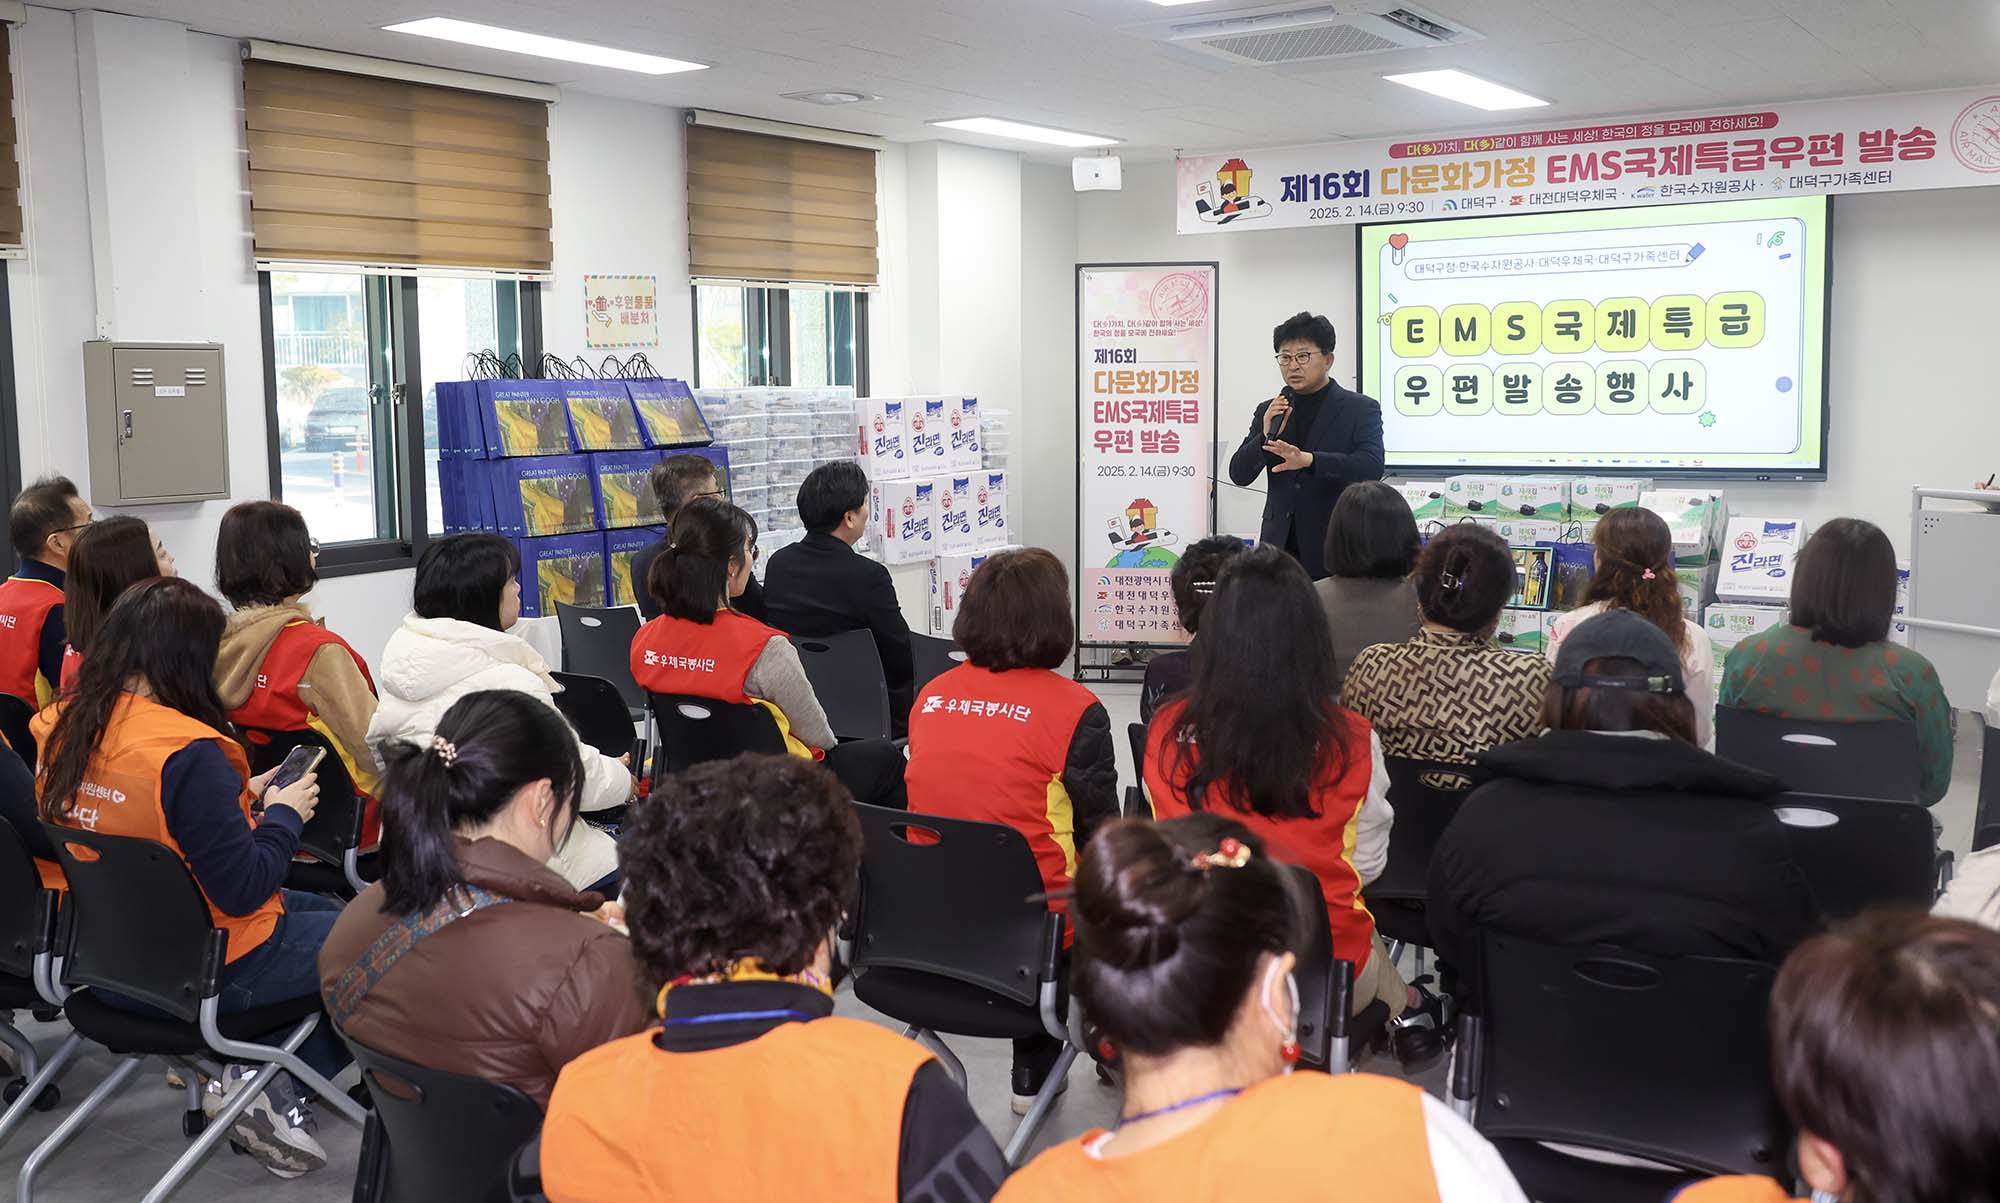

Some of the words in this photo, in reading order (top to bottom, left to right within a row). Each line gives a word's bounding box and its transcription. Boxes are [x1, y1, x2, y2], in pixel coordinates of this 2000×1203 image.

[1520, 135, 1543, 147] 함께
[1546, 133, 1569, 144] 사는
[1572, 130, 1599, 142] 세상!
[1602, 126, 1637, 140] 한국의
[1641, 125, 1664, 137] 정을
[1669, 120, 1705, 135] 모국에
[1709, 116, 1764, 132] 전하세요!
[1280, 168, 1370, 202] 제16회
[1380, 156, 1536, 195] 다문화가정
[1547, 132, 1844, 185] EMS국제특급우편
[1859, 126, 1937, 164] 발송
[1660, 179, 1756, 198] 한국수자원공사
[1789, 170, 1892, 189] 대덕구가족센터
[1461, 196, 1497, 209] 대덕구
[1529, 187, 1617, 206] 대전대덕우체국
[1309, 207, 1342, 220] 2025.
[1345, 206, 1355, 217] 2.
[1359, 202, 1395, 216] 14.(금)
[1397, 201, 1425, 213] 9:30
[615, 296, 653, 310] 후원물품
[620, 312, 649, 325] 배분처
[1094, 348, 1137, 364] 제16회
[1093, 370, 1200, 395] 다문화가정
[1093, 400, 1199, 424] EMS국제특급
[875, 434, 900, 456] 진라면
[913, 432, 940, 453] 진라면
[951, 429, 975, 449] 진라면
[1093, 429, 1134, 454] 우편
[1140, 429, 1180, 454] 발송
[1097, 466, 1127, 477] 2025.
[1128, 466, 1138, 477] 2.
[1140, 465, 1170, 478] 14.(금)
[1172, 466, 1195, 477] 9:30
[942, 510, 967, 532] 진라면
[978, 505, 1001, 526] 진라면
[902, 517, 929, 540] 진라면
[1730, 552, 1782, 571] 진라면
[1114, 575, 1162, 586] 대전광역시
[1115, 590, 1171, 601] 대전대덕우
[660, 653, 715, 673] 우체국봉사단
[945, 698, 1032, 723] 우체국봉사단
